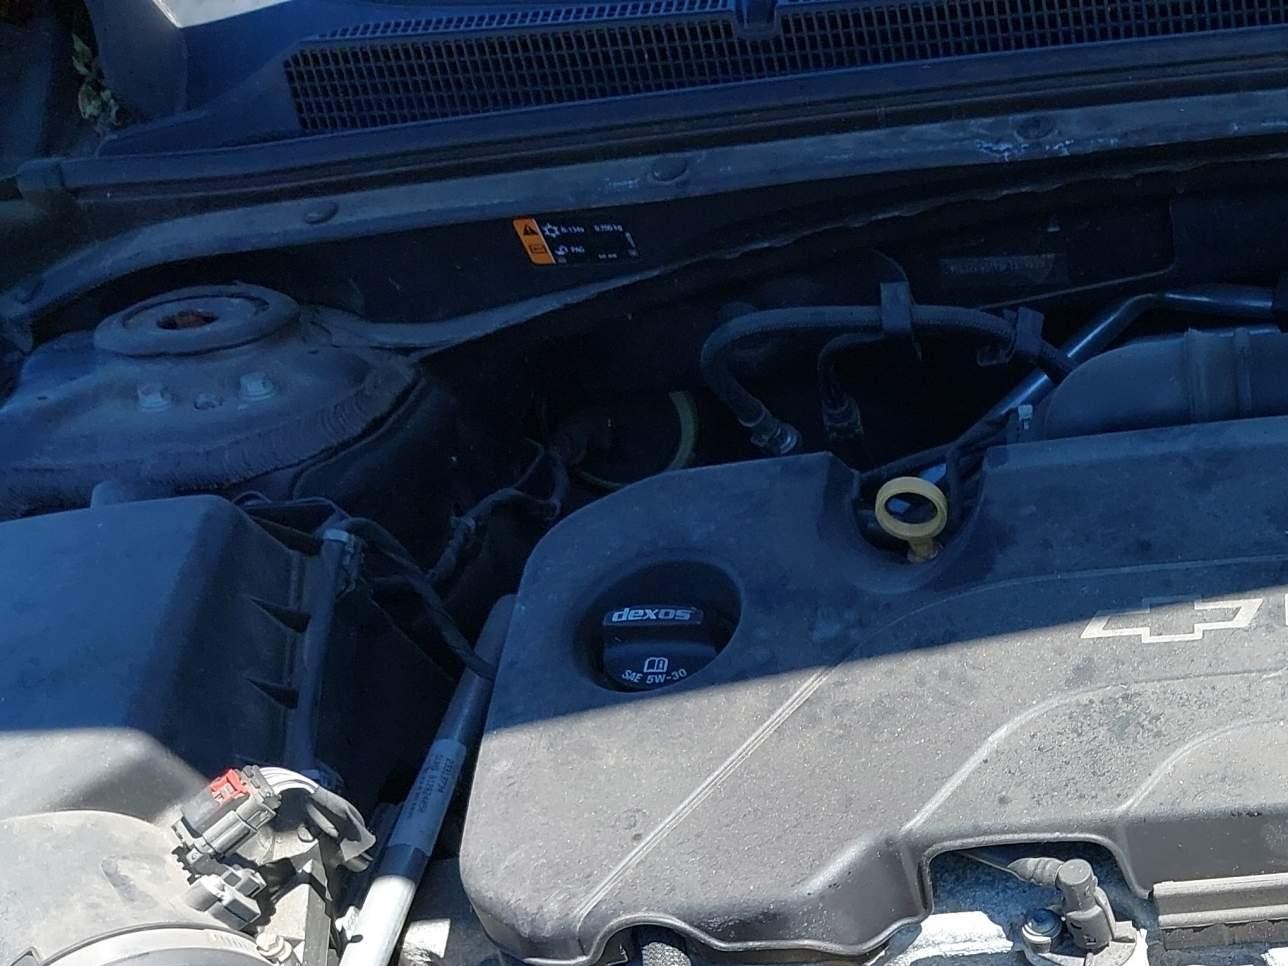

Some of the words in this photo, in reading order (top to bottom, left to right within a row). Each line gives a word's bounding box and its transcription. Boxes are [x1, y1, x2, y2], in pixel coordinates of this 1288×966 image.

[611, 607, 691, 622] dexos
[621, 669, 643, 683] SAE
[645, 668, 688, 684] 5W-30
